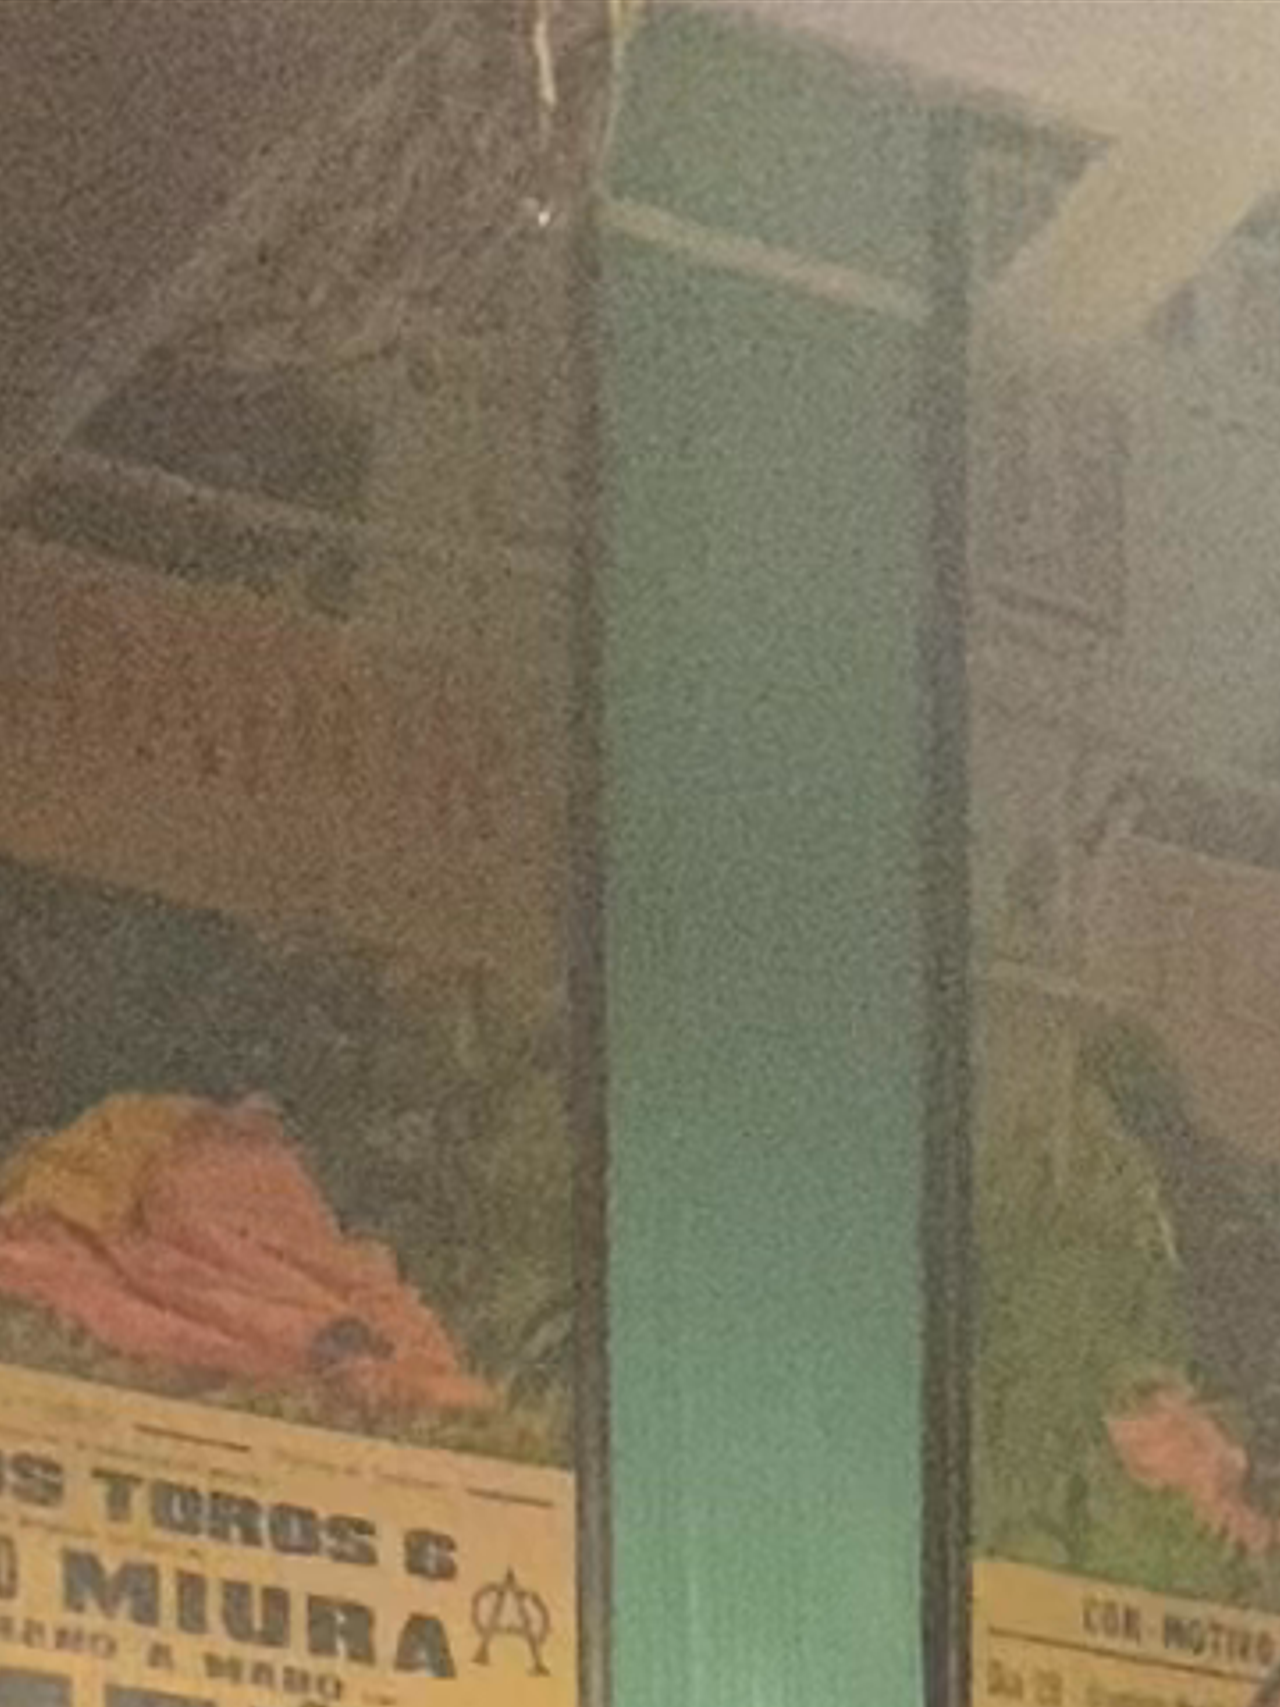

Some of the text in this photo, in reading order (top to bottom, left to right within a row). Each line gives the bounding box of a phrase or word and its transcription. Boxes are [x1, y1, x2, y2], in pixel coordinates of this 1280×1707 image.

[91, 1467, 379, 1567] TOROS
[403, 1527, 459, 1582] 6
[62, 1547, 457, 1679] MIURA
